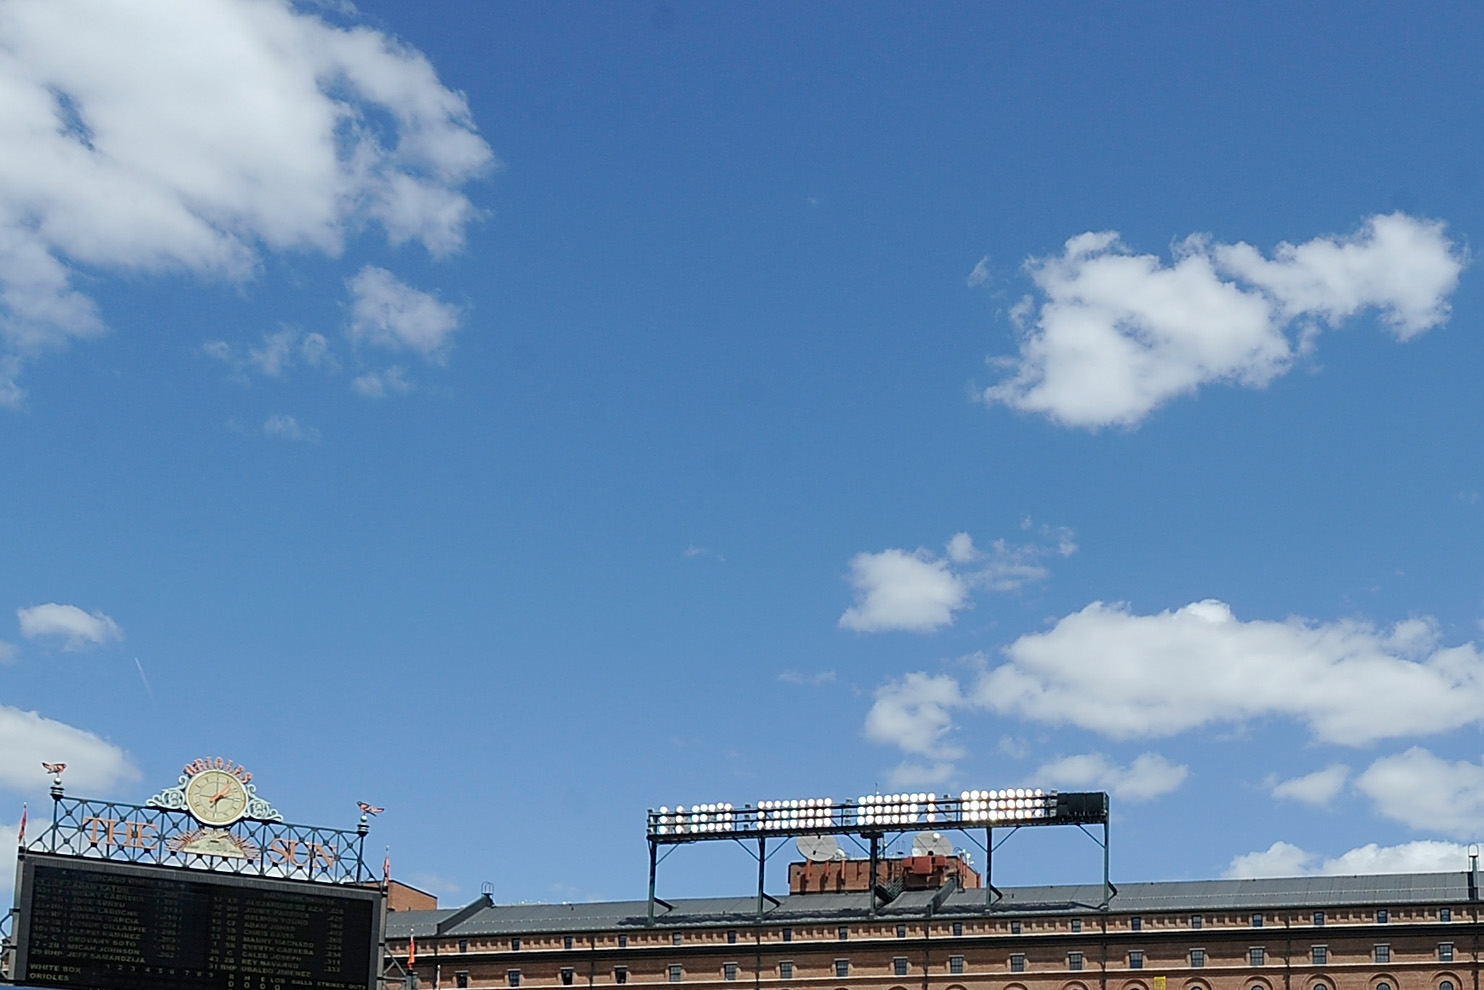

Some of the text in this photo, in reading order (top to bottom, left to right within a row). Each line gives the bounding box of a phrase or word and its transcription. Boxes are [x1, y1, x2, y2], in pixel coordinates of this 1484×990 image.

[186, 756, 253, 784] ORIOLES
[84, 815, 336, 868] THE SUN
[29, 962, 82, 973] WHITE SOX
[29, 971, 70, 981] ORIOLES
